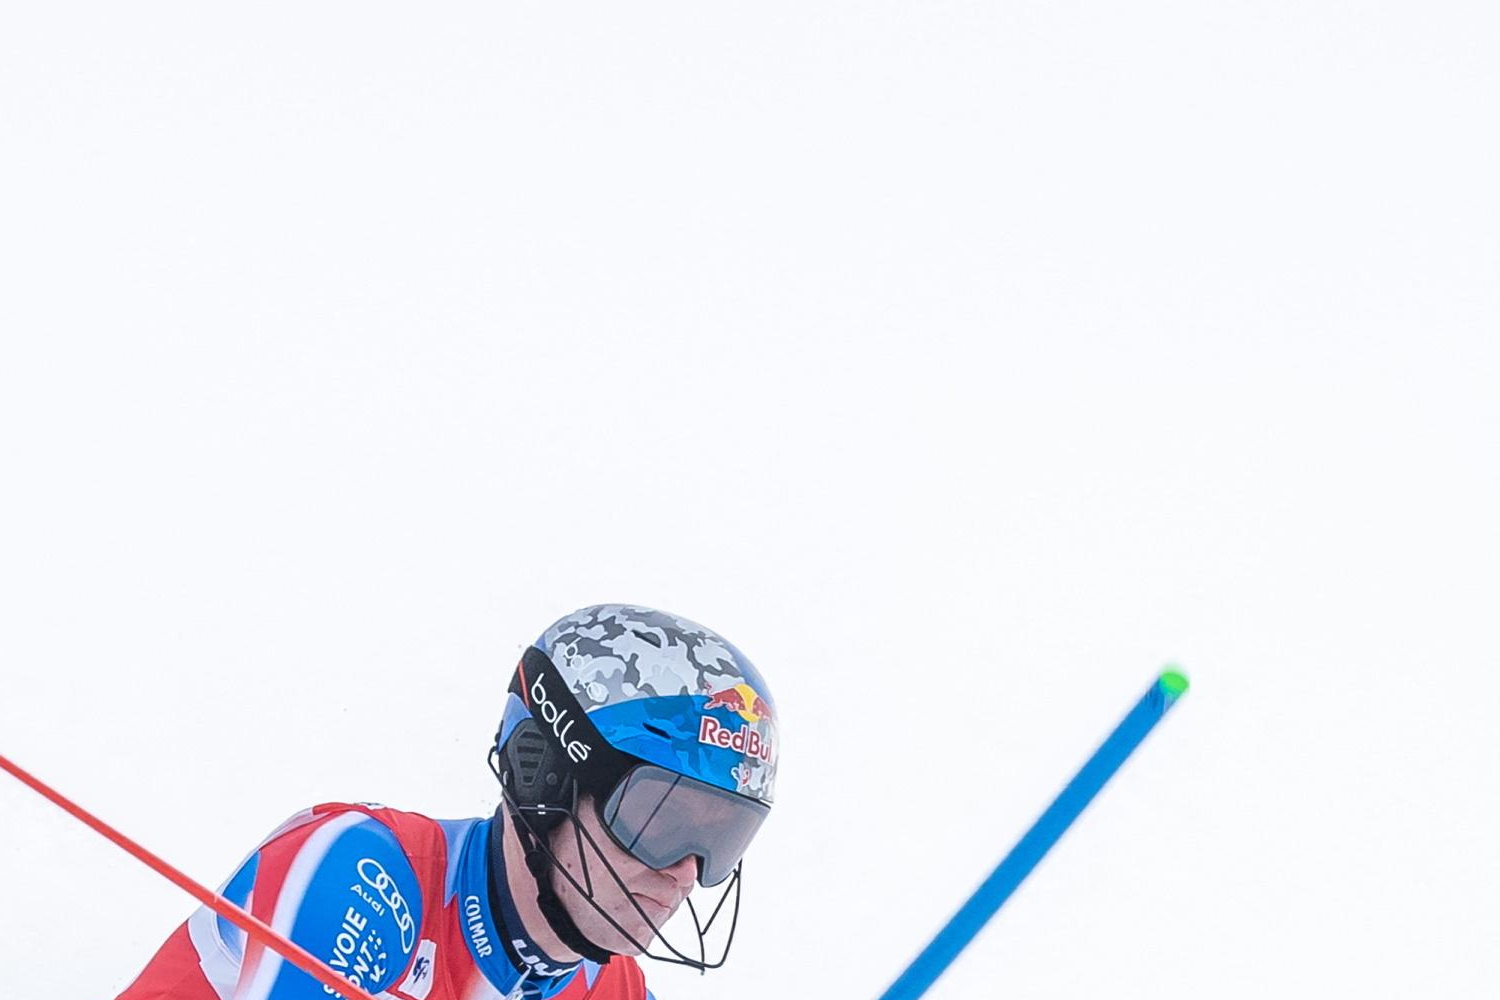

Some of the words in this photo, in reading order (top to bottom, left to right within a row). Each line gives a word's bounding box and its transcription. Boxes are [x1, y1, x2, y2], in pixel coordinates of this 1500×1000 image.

[699, 715, 748, 753] Red
[351, 884, 386, 917] Audi
[464, 895, 493, 958] COLMAR
